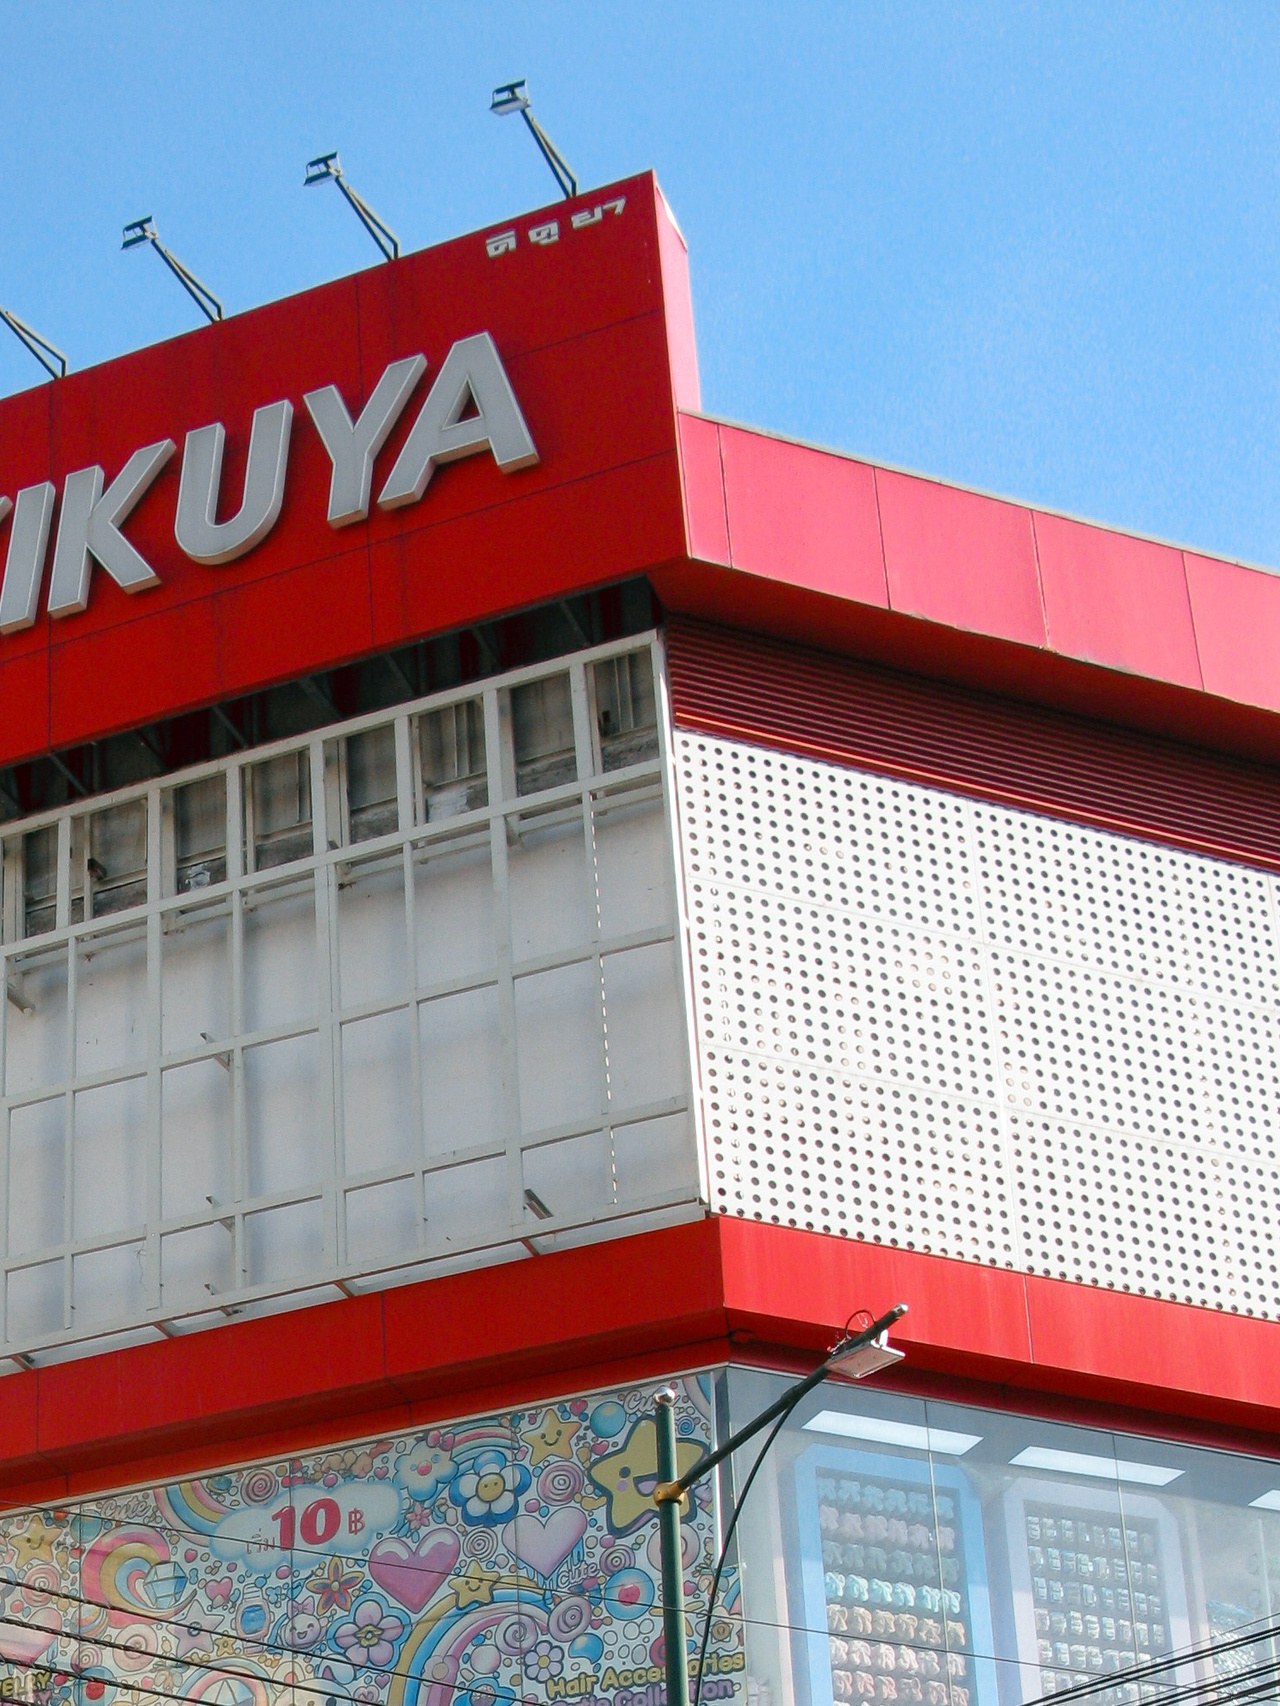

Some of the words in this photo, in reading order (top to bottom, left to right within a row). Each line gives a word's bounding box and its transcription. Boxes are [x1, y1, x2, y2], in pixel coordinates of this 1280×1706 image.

[624, 1390, 680, 1414] Cu
[271, 1497, 341, 1551] 10
[546, 1672, 599, 1699] Hair
[600, 1651, 746, 1692] Acceories
